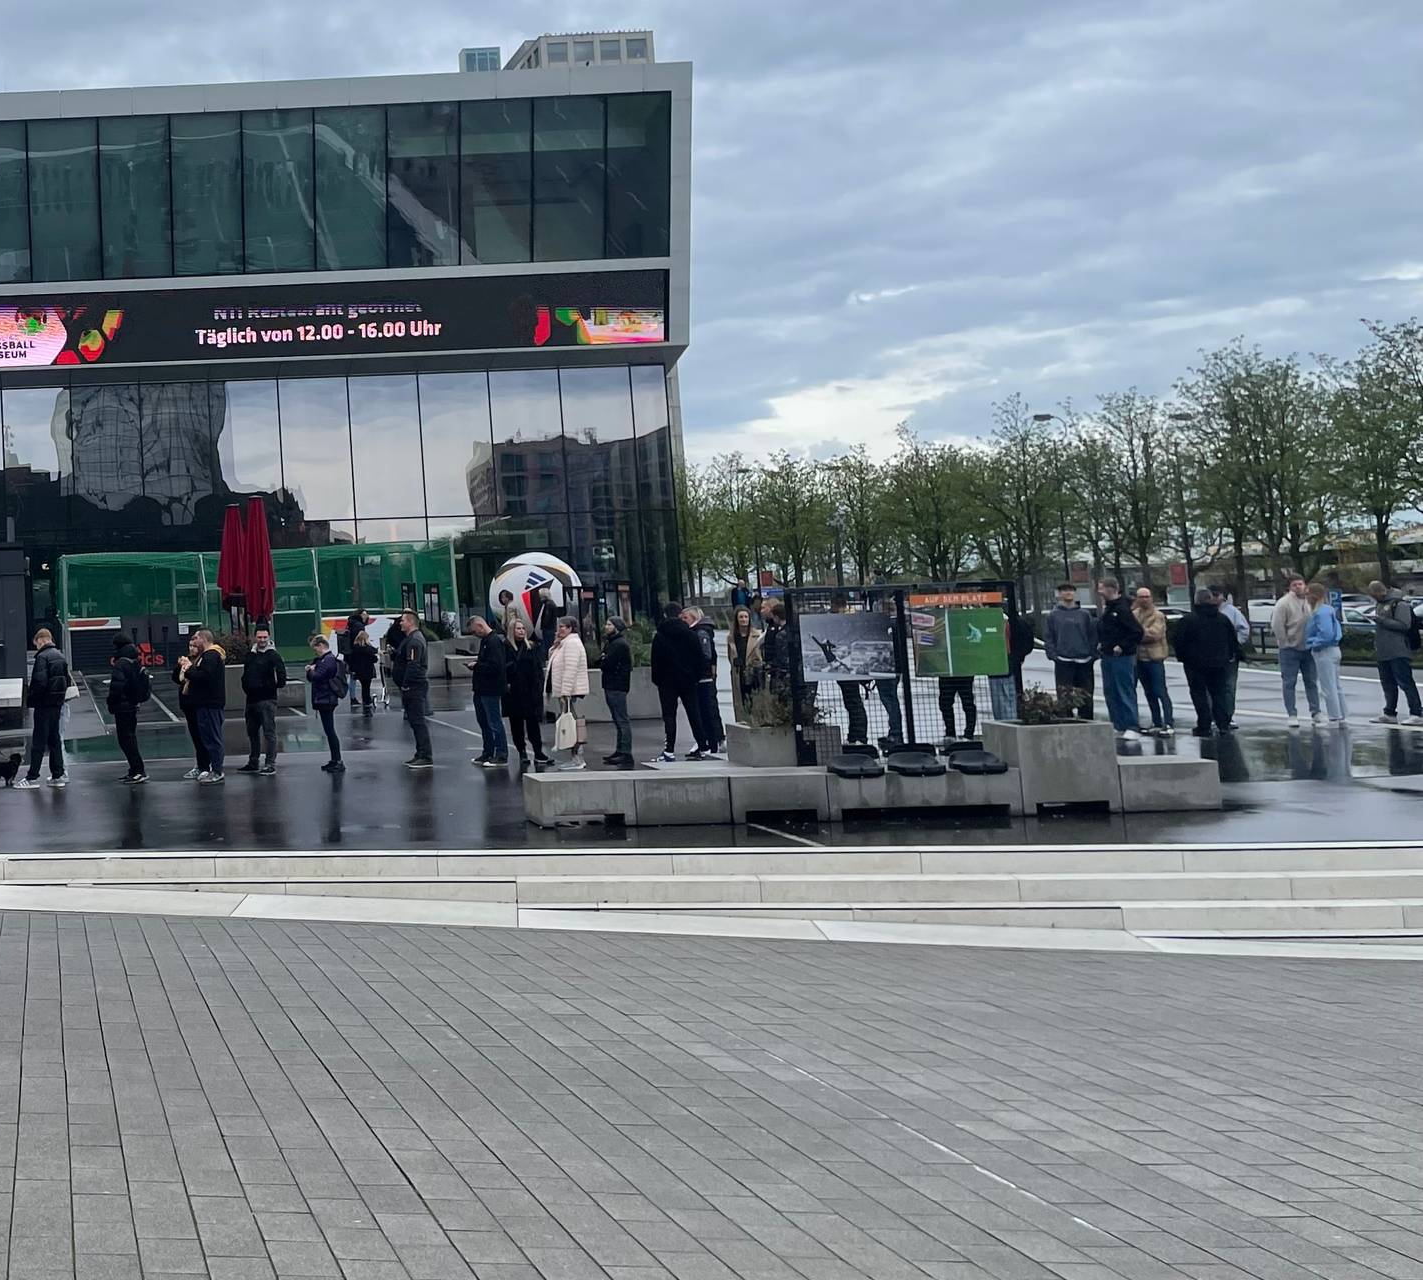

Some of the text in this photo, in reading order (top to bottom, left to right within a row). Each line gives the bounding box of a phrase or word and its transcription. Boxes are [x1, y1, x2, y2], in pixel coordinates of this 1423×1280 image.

[195, 327, 257, 348] Täglich
[261, 328, 293, 342] von
[297, 324, 344, 341] 12.00
[358, 321, 406, 338] 16.00
[410, 319, 442, 337] Uhr
